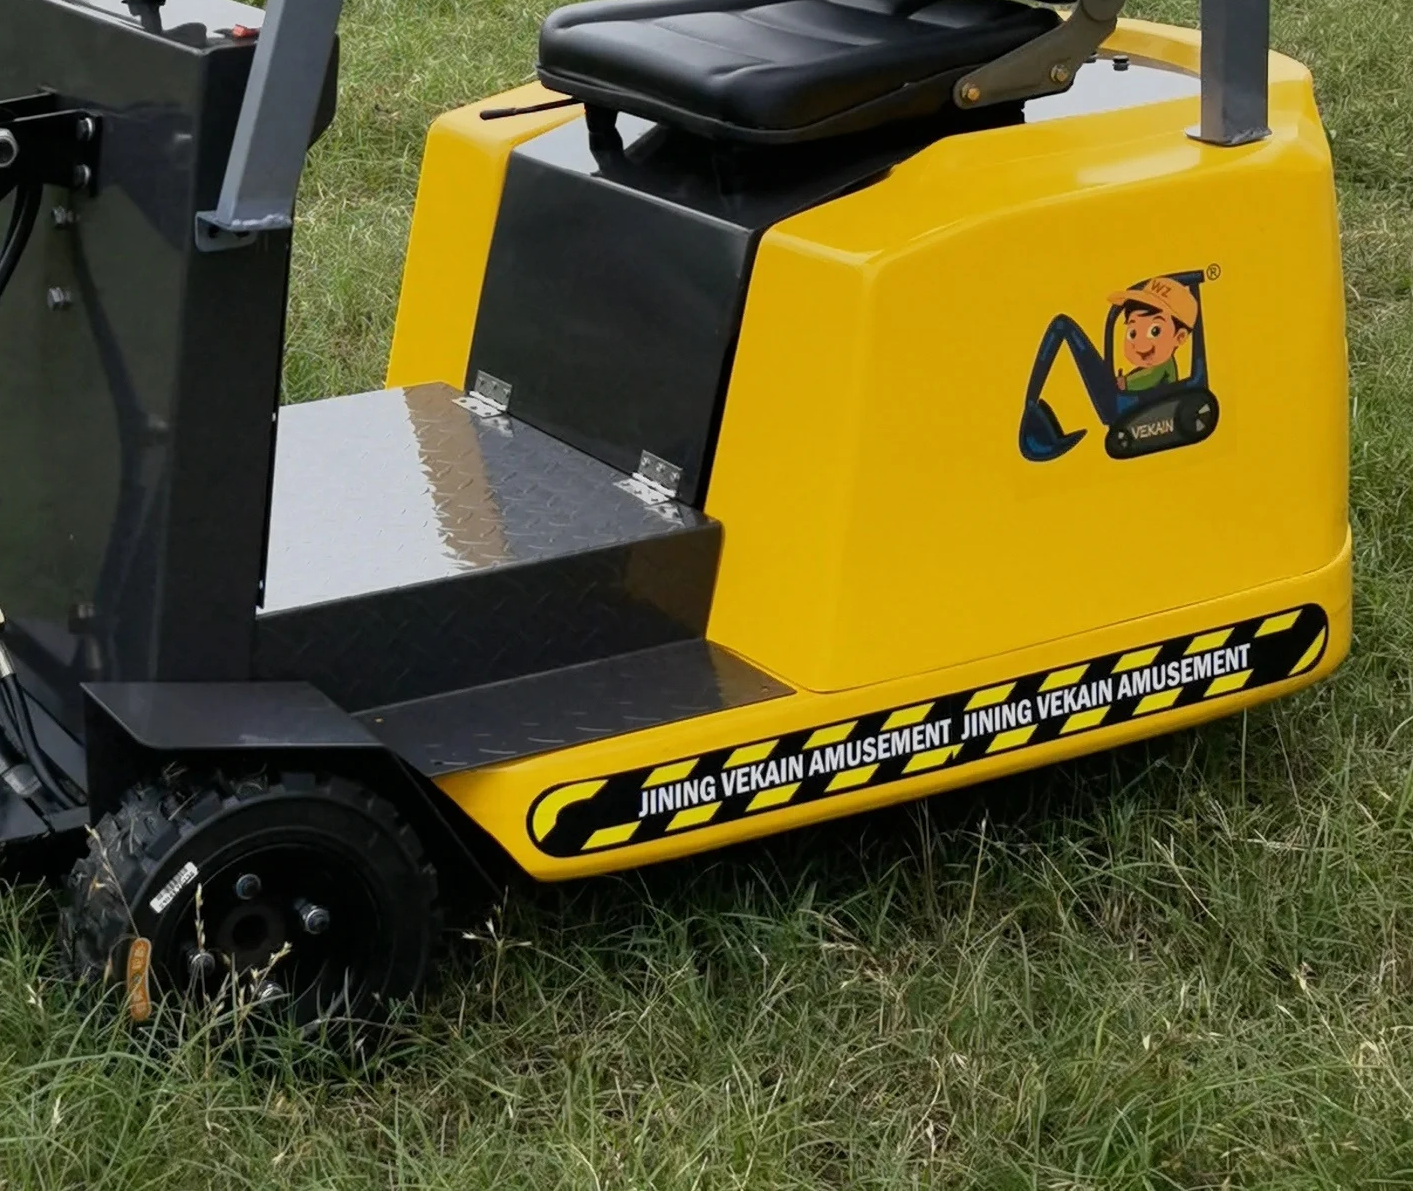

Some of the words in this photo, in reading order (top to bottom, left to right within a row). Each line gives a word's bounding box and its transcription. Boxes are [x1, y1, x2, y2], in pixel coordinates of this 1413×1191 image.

[1151, 280, 1171, 298] WZ
[1131, 419, 1174, 439] VEKAIN
[638, 775, 716, 818] JINING
[721, 753, 805, 797] VEKAIN
[808, 719, 951, 776] AMUSEMENT
[960, 699, 1032, 740] JINING
[1036, 678, 1113, 720] VEKAIN
[1117, 643, 1251, 701] AMUSEMENT
